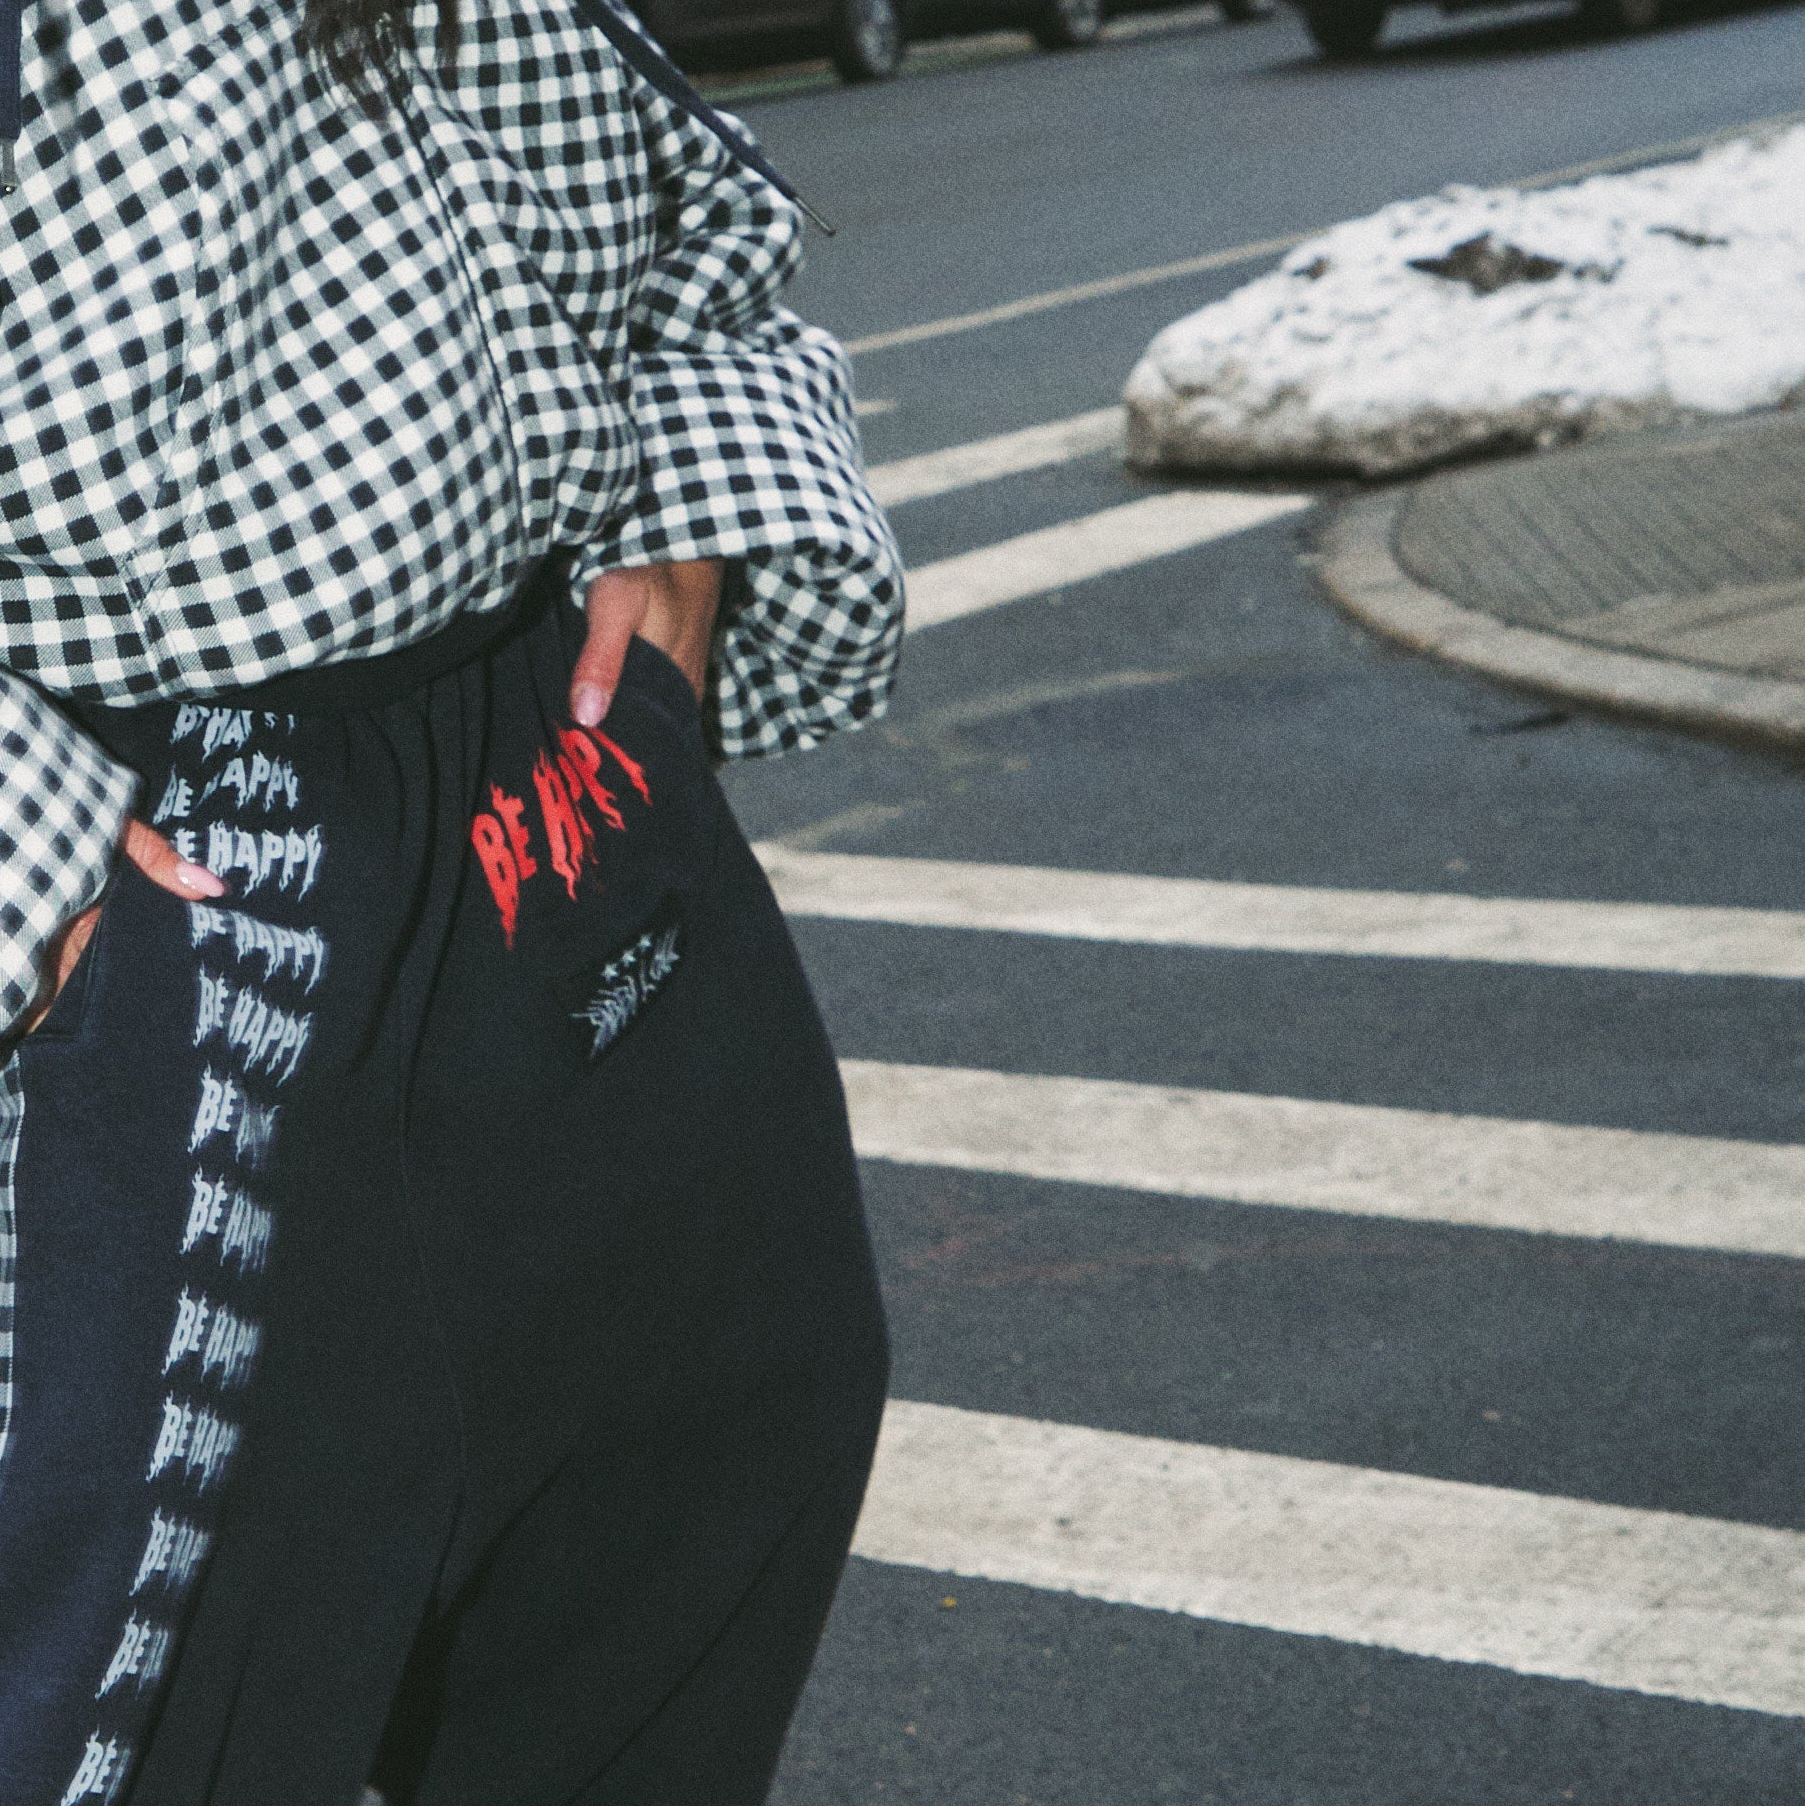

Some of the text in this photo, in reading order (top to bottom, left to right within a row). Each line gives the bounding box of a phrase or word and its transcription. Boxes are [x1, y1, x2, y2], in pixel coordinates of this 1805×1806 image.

[196, 749, 300, 813] APPY
[170, 818, 323, 903] E HAPPY
[471, 781, 537, 951] BE
[230, 909, 325, 996] HAPPY
[192, 960, 314, 1088] BE HAPPY
[187, 1060, 238, 1154] BE
[179, 1161, 229, 1255] BE
[161, 1281, 209, 1377] BE
[145, 1389, 193, 1483] BE
[127, 1505, 177, 1597] BE
[94, 1606, 151, 1701] BE
